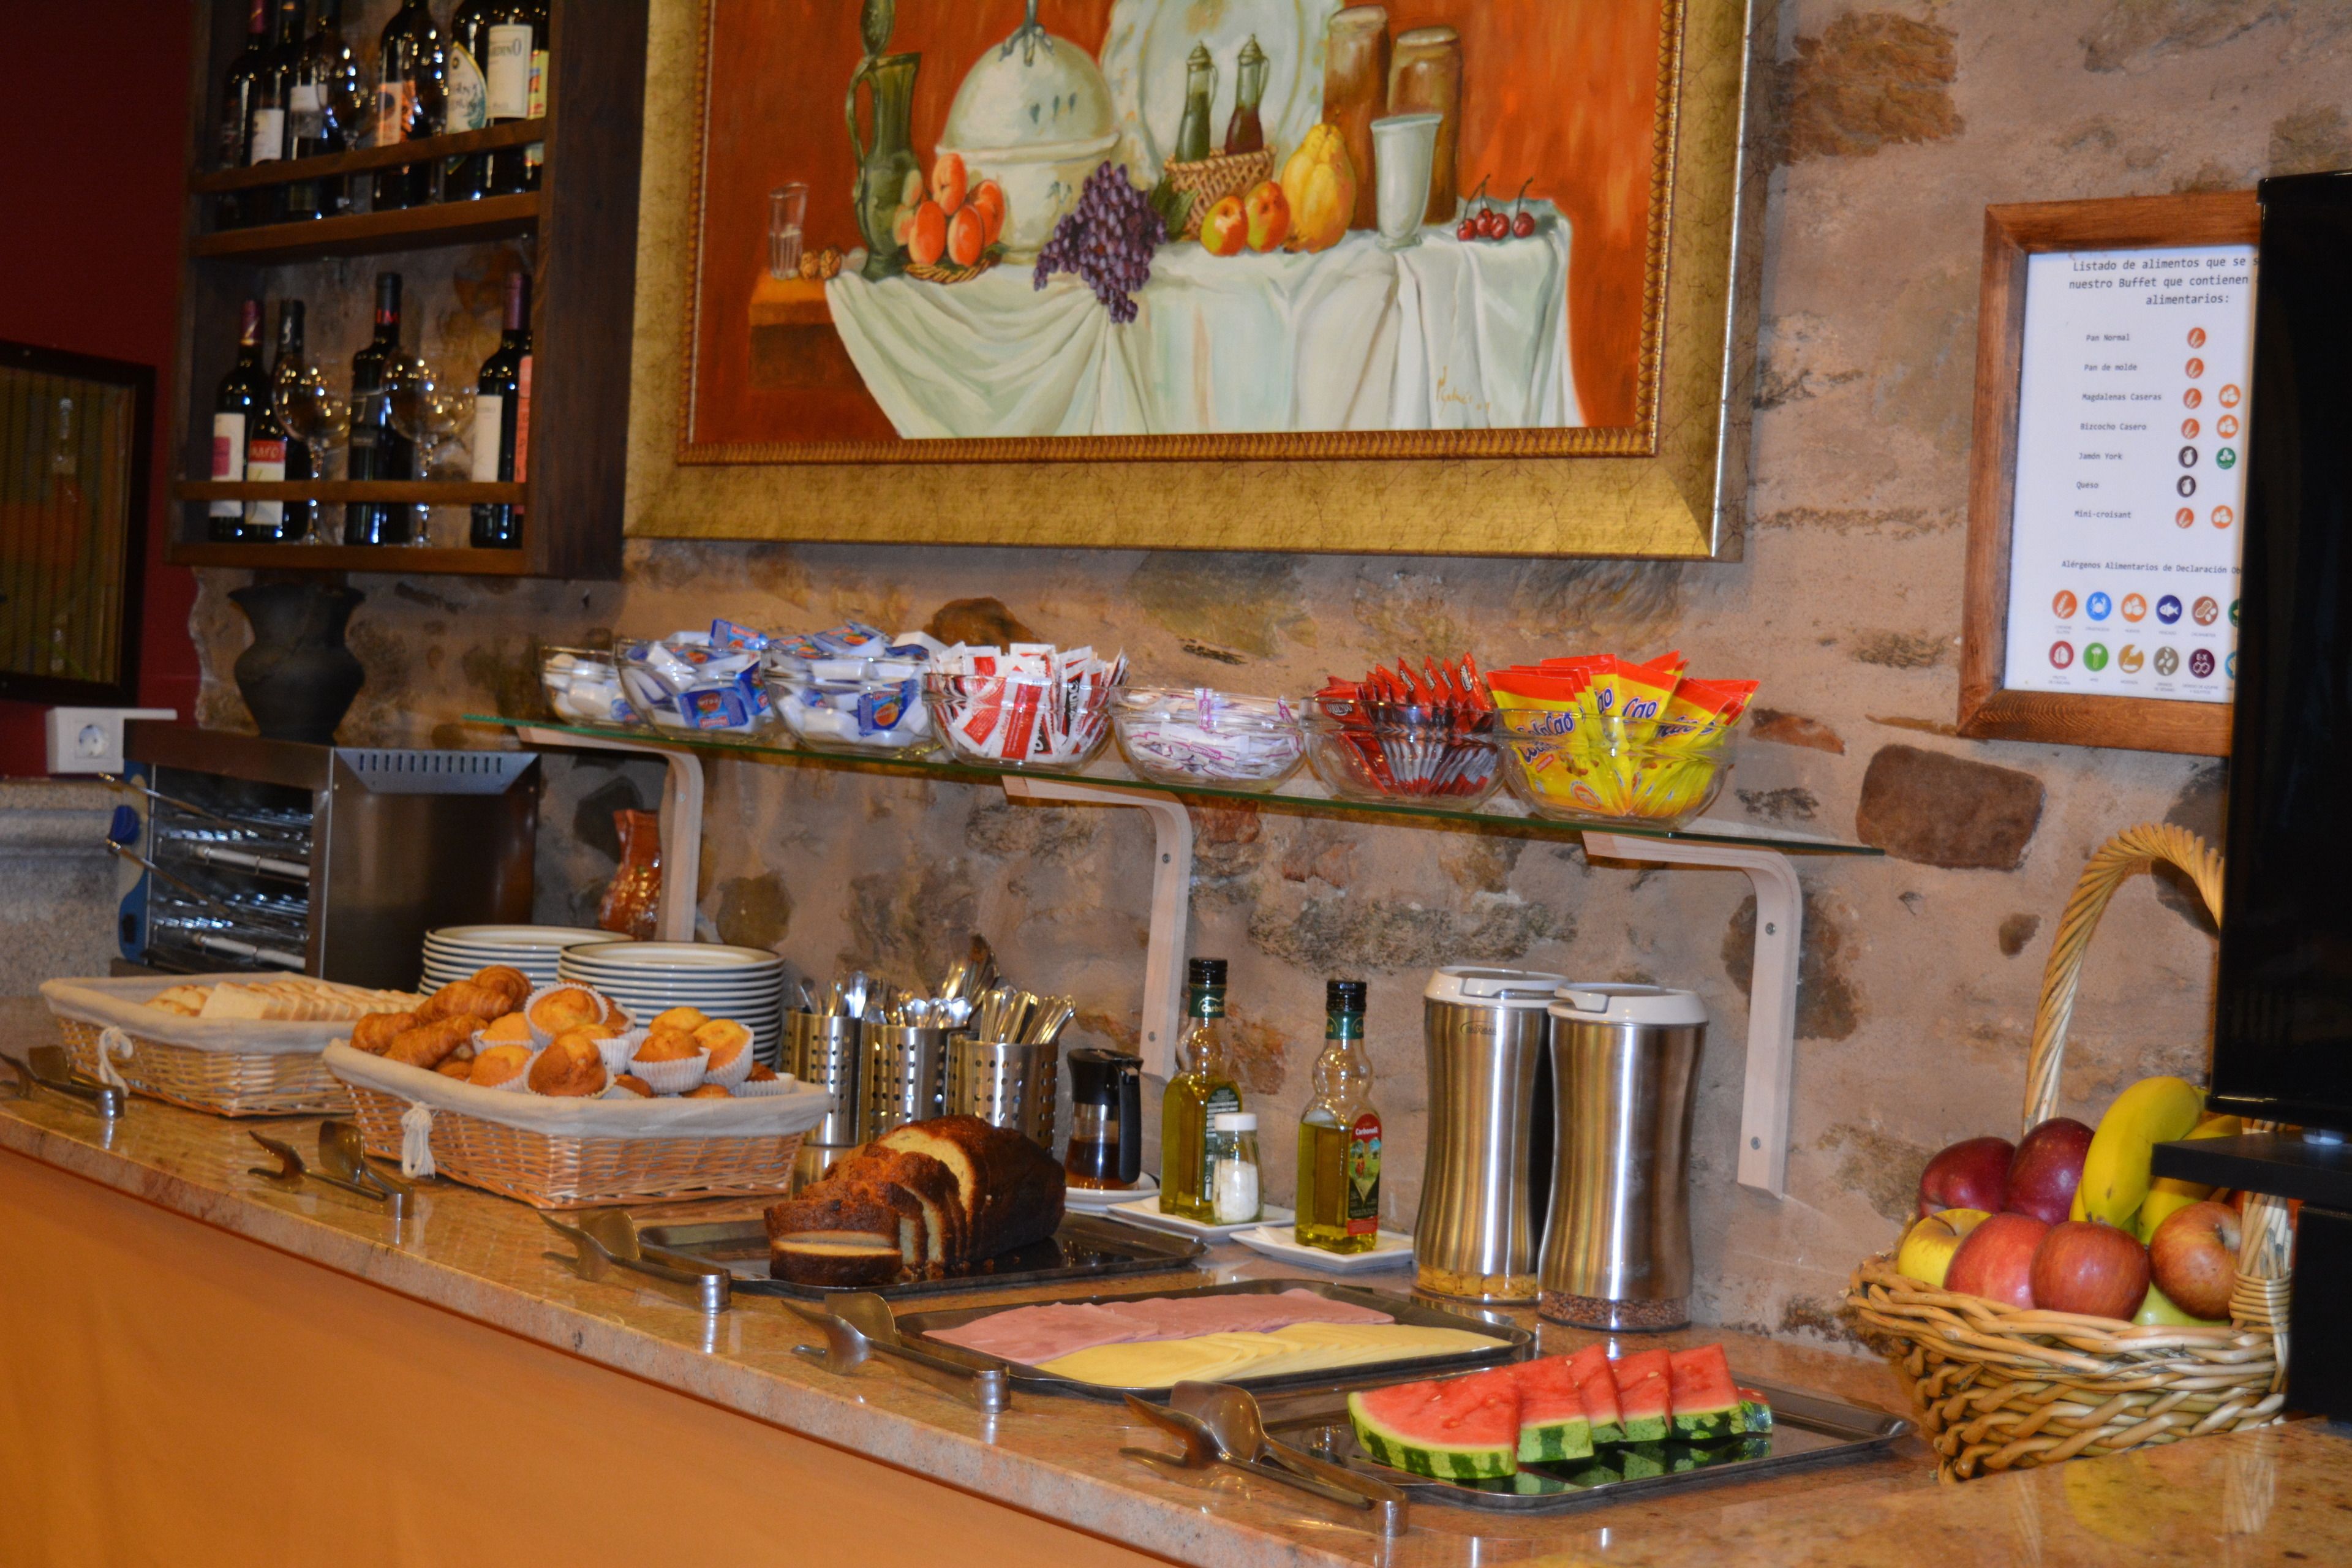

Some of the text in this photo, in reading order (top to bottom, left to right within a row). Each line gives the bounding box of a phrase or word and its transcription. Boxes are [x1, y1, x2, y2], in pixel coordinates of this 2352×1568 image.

[2072, 259, 2118, 272] Listado
[2122, 259, 2136, 270] de
[2142, 258, 2199, 270] alimentos
[2206, 258, 2226, 270] que
[2233, 257, 2247, 266] se
[2068, 274, 2250, 290] nuestro Buffet que contienen
[2146, 293, 2229, 305] alimentarios:
[2103, 333, 2130, 342] Normal
[2084, 363, 2098, 372] Pan
[2114, 363, 2138, 371] molde
[2082, 393, 2162, 402] Magdalenas Caseras
[2079, 422, 2116, 431] Bizcocho
[2076, 481, 2100, 490] Queso
[2074, 510, 2132, 519] Mini-croisant
[2061, 560, 2101, 570] Alérgenos
[2105, 561, 2159, 571] Alimentarios
[2162, 564, 2173, 572] de
[2176, 564, 2228, 574] Declaración
[1355, 1126, 1379, 1136] Carbonell
